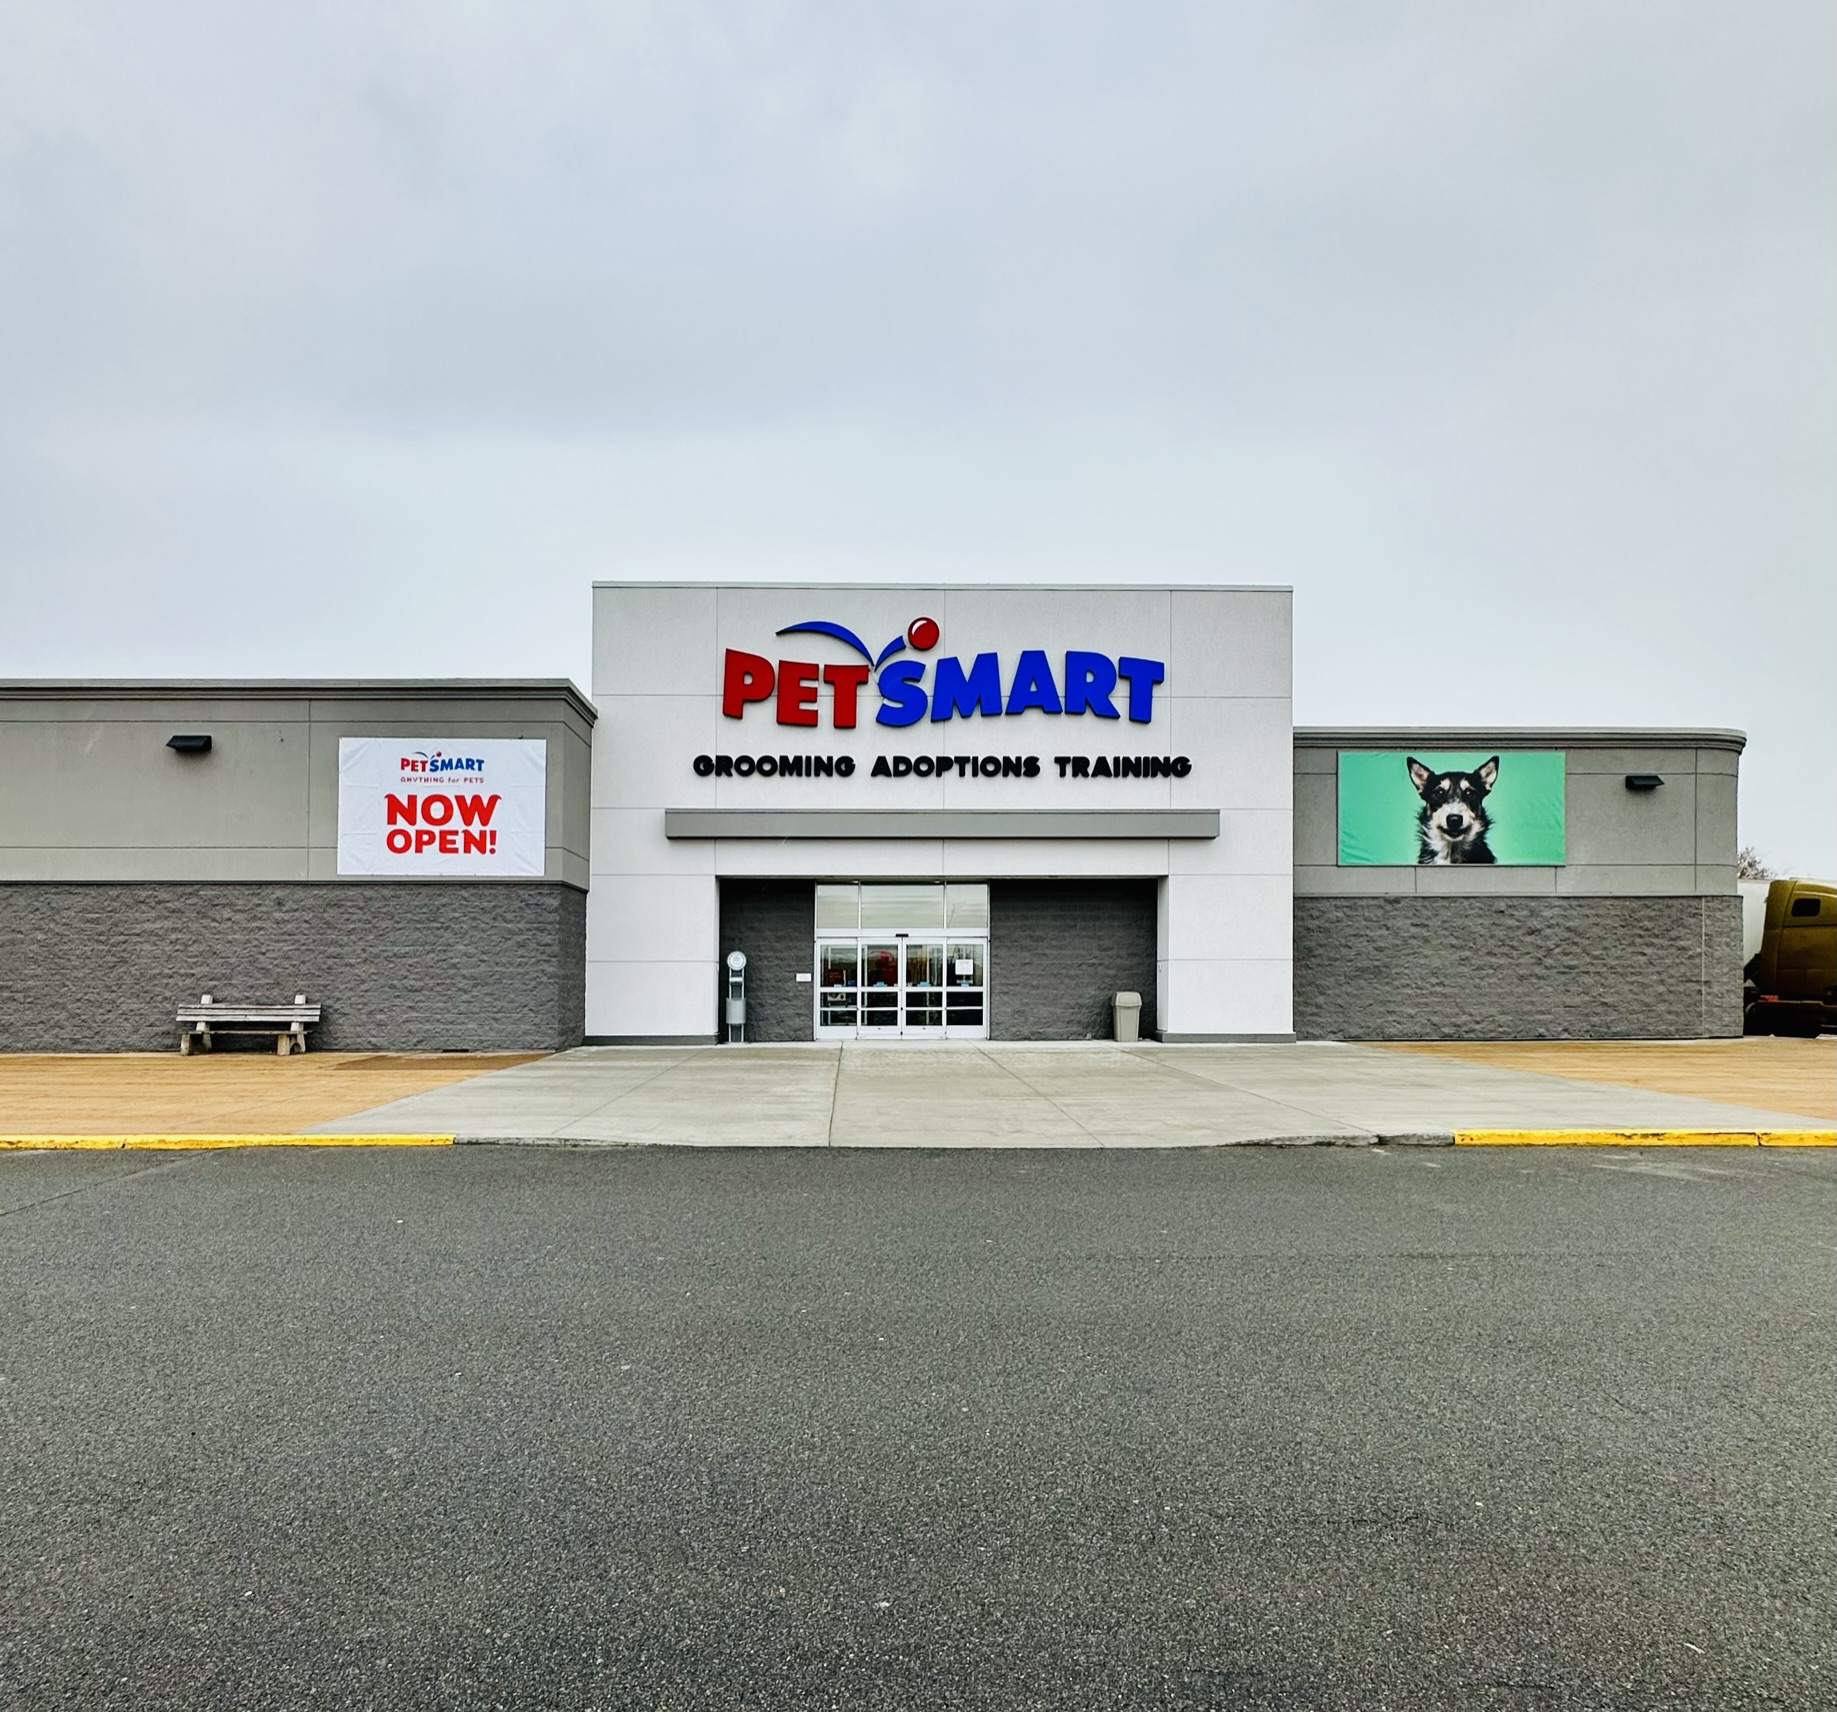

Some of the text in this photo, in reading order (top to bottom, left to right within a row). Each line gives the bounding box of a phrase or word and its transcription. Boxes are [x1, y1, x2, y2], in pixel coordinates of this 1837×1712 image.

[722, 648, 1165, 728] PETSMART
[400, 757, 484, 772] PETSMART
[693, 755, 1192, 778] GROOMING ADOPTIONS TRAINING
[448, 776, 460, 784] for
[384, 793, 502, 827] NOW
[386, 828, 497, 855] OPEN!
